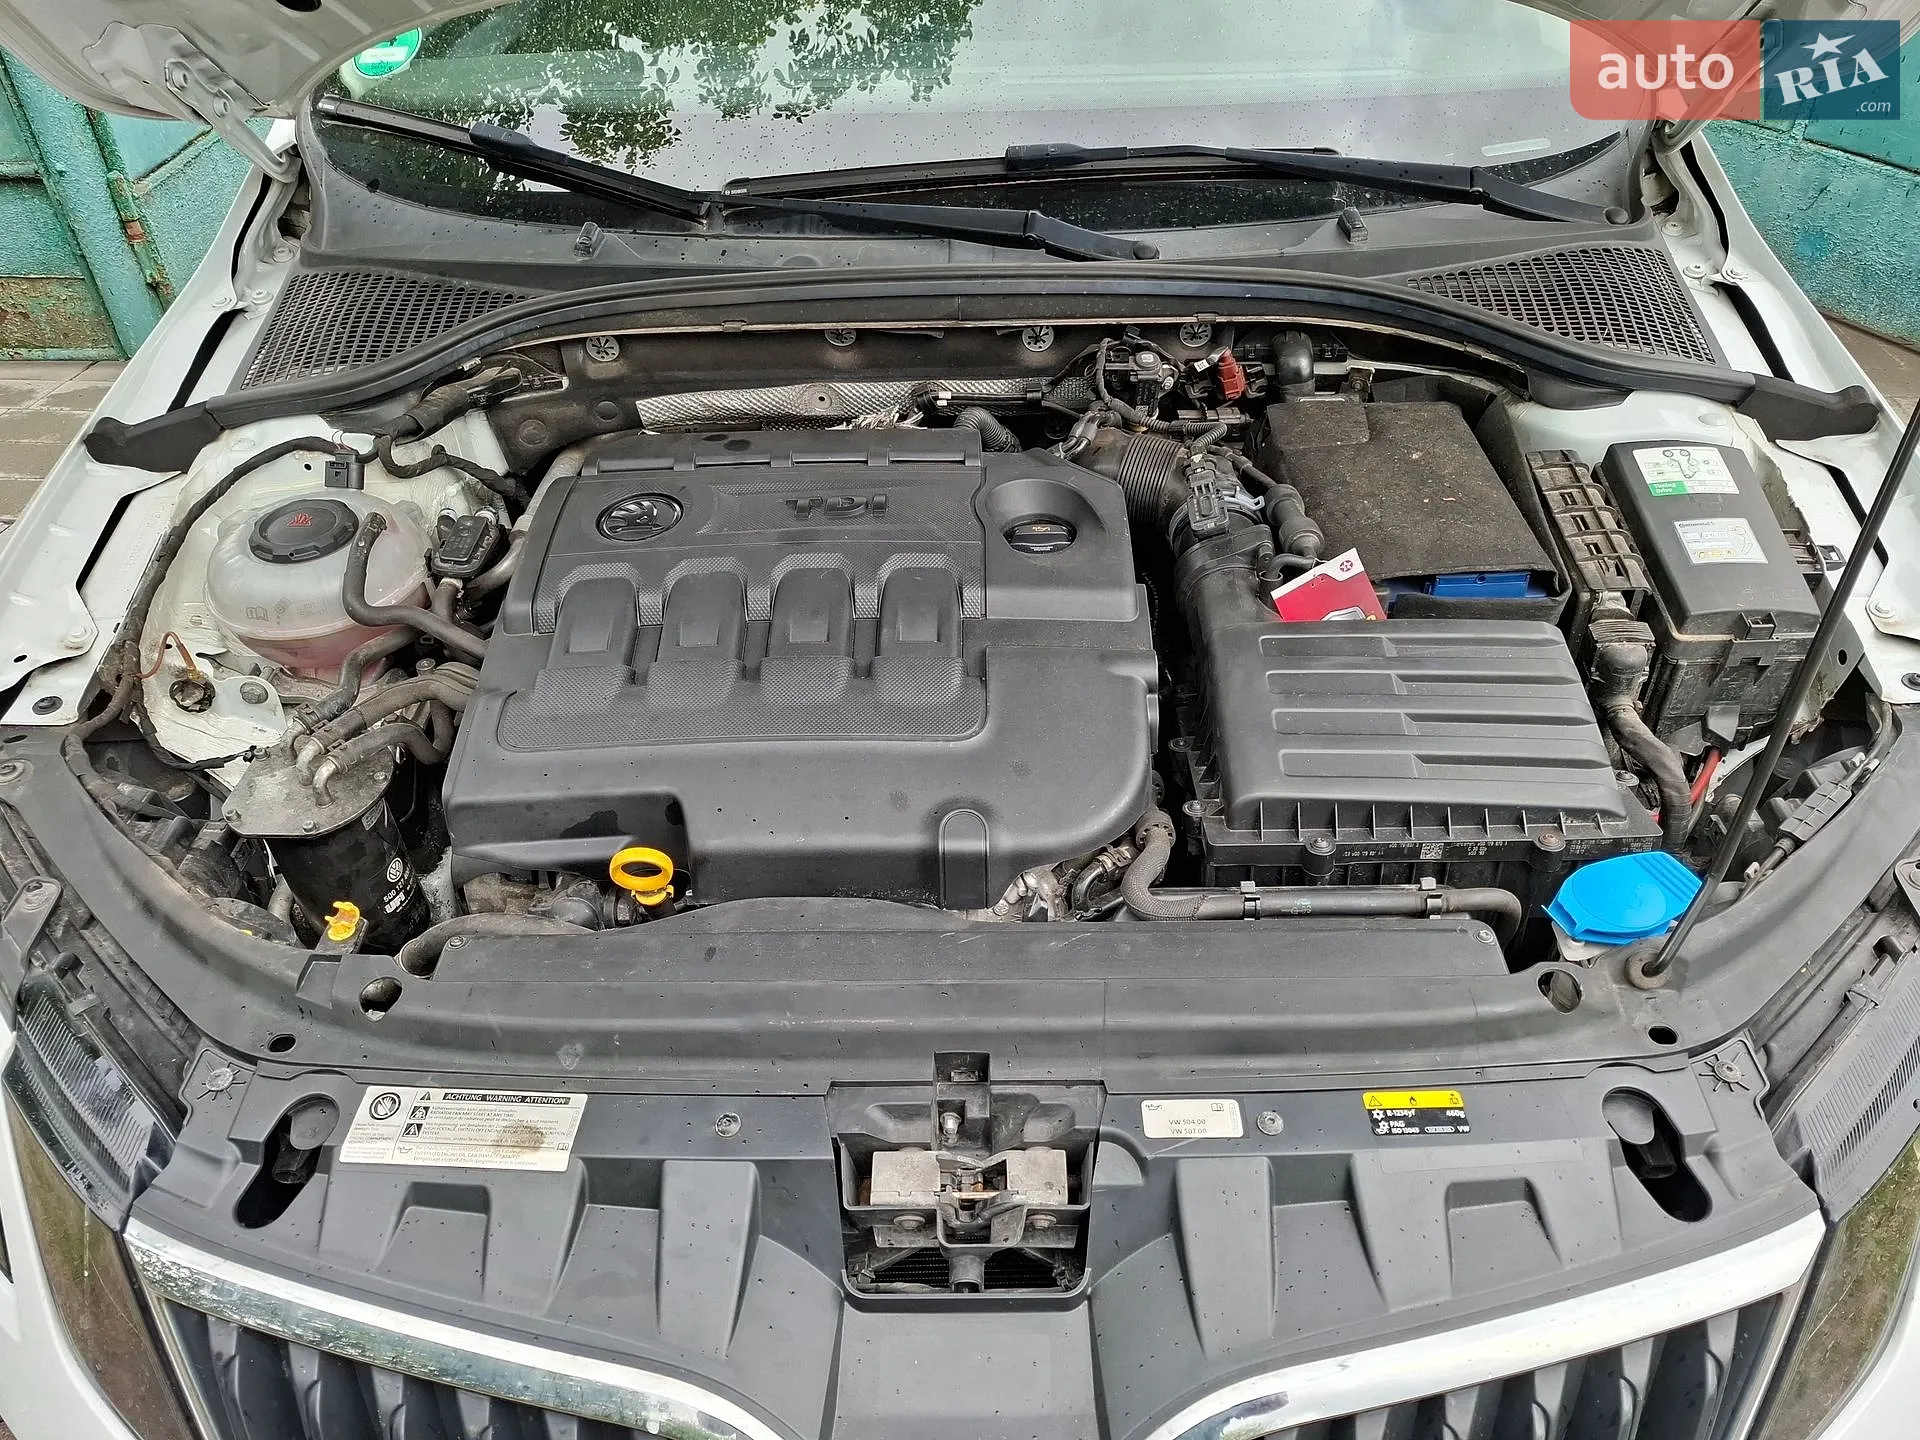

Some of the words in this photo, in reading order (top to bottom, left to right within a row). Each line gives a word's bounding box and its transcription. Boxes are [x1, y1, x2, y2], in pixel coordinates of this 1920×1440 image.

[785, 494, 888, 519] TDI
[445, 1093, 482, 1101] ACHTUNG
[486, 1094, 522, 1102] WARNING
[525, 1096, 565, 1104] ATTENTION
[1386, 1109, 1415, 1118] R-1234yf
